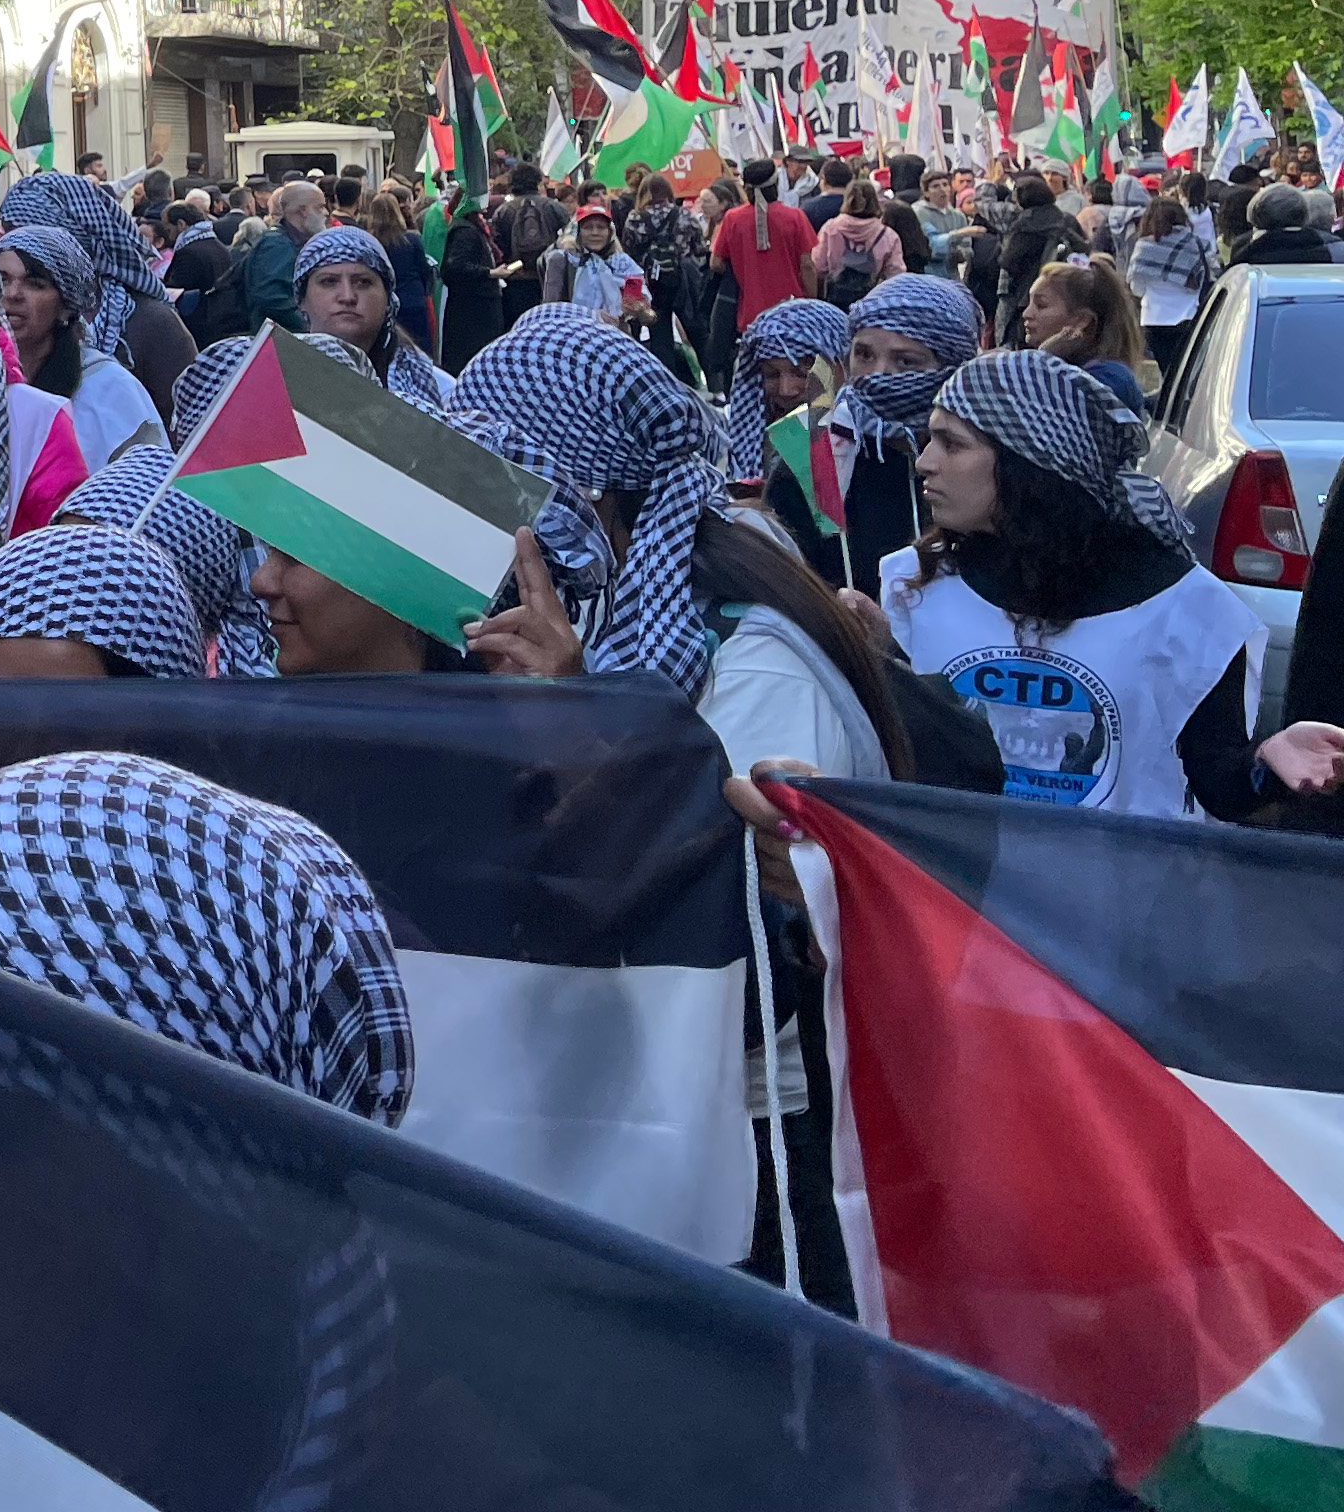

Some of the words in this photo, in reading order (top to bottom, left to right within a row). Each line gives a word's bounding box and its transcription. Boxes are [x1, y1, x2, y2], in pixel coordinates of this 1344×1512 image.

[973, 666, 1074, 707] CTD
[981, 650, 995, 660] DE
[1079, 672, 1120, 742] DESOCUPADOS
